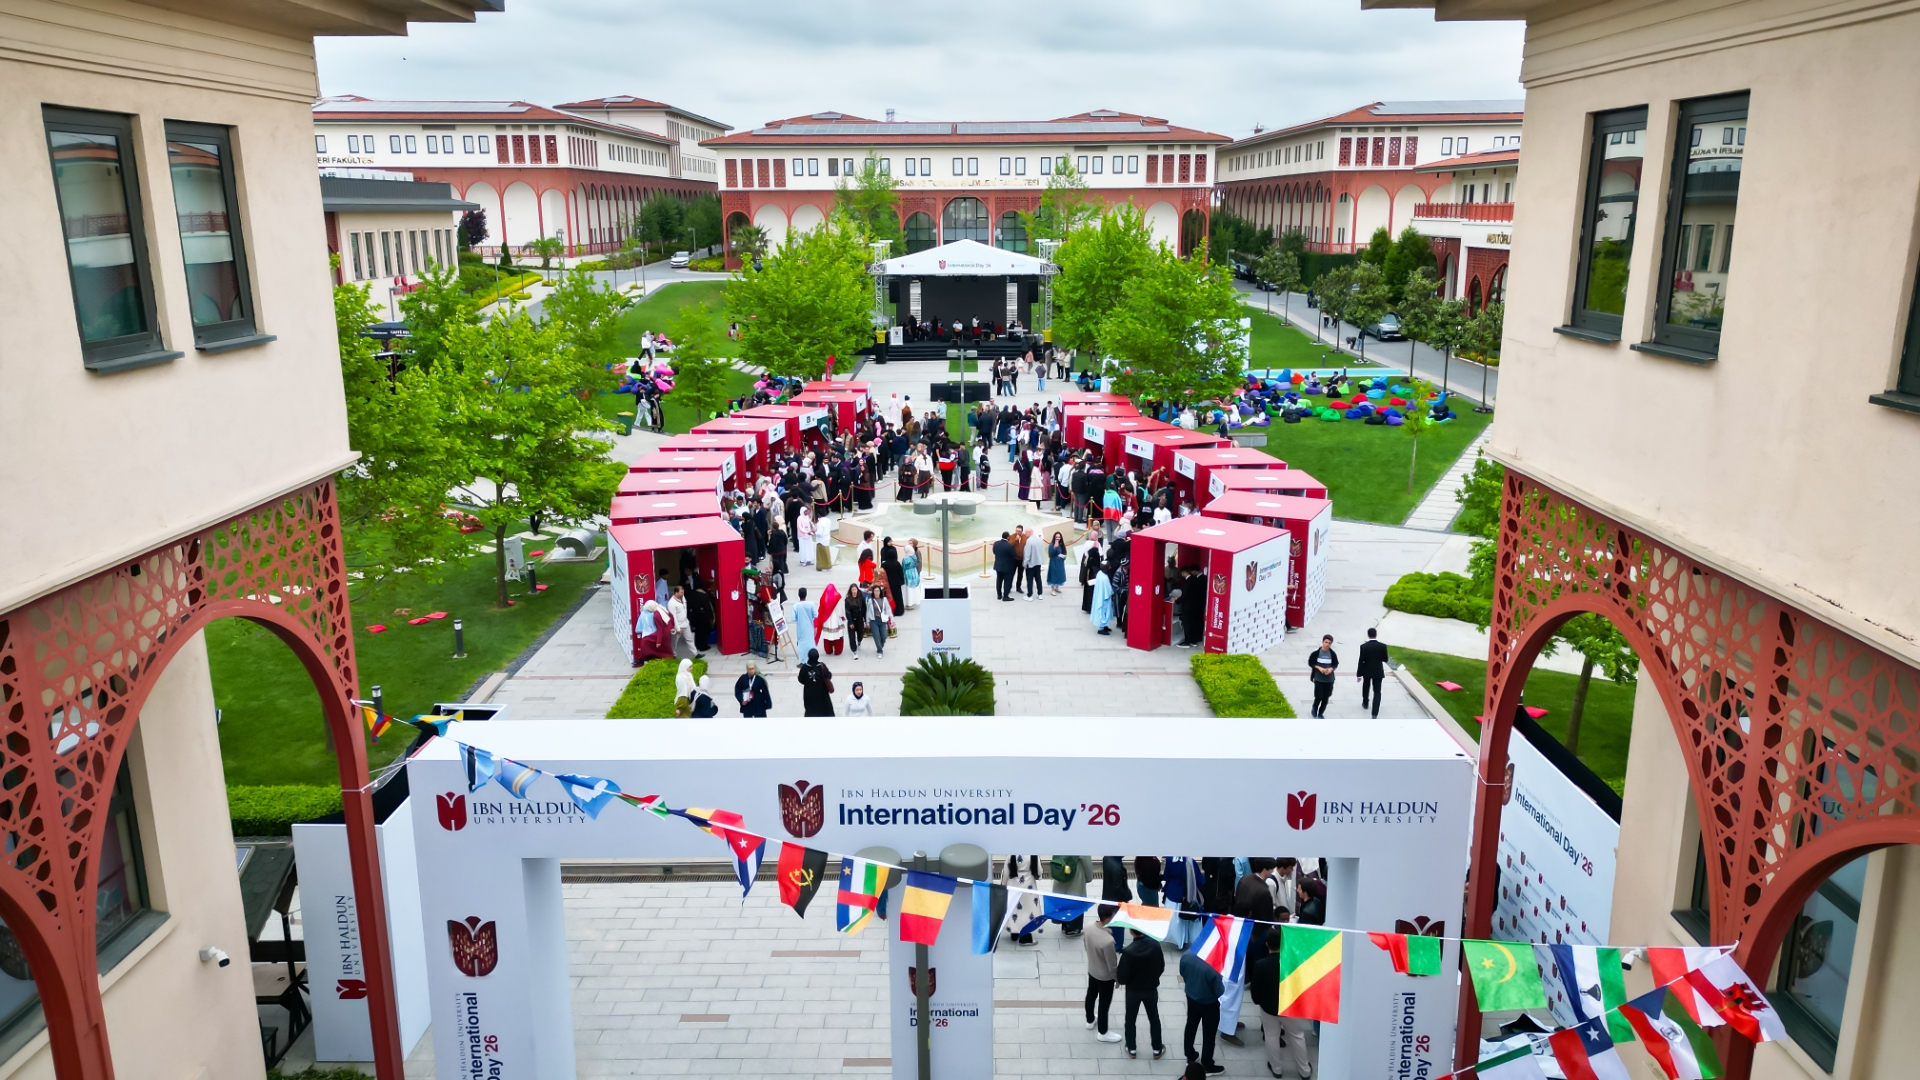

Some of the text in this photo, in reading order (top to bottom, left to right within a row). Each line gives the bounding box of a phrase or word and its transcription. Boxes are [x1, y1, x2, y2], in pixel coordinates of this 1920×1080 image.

[317, 155, 330, 164] ERİ
[841, 788, 1013, 798] IBN HALDUN UNIVERSITY
[472, 802, 586, 815] IBN HALDUN
[839, 803, 1121, 832] International Day '26
[1323, 801, 1439, 815] IBN HALDUN
[474, 816, 586, 824] UNIVERSITY
[1322, 816, 1437, 824] UNIVERSITY
[1515, 787, 1563, 846] International
[1563, 836, 1580, 866] Day
[335, 895, 354, 975] IBN HALDUN
[347, 896, 360, 975] UNIVERSITY
[909, 1007, 979, 1017] Inrnational
[463, 992, 484, 1080] nternational
[484, 1034, 499, 1057] '26
[1397, 992, 1416, 1080] nternational
[1415, 1034, 1430, 1057] '26
